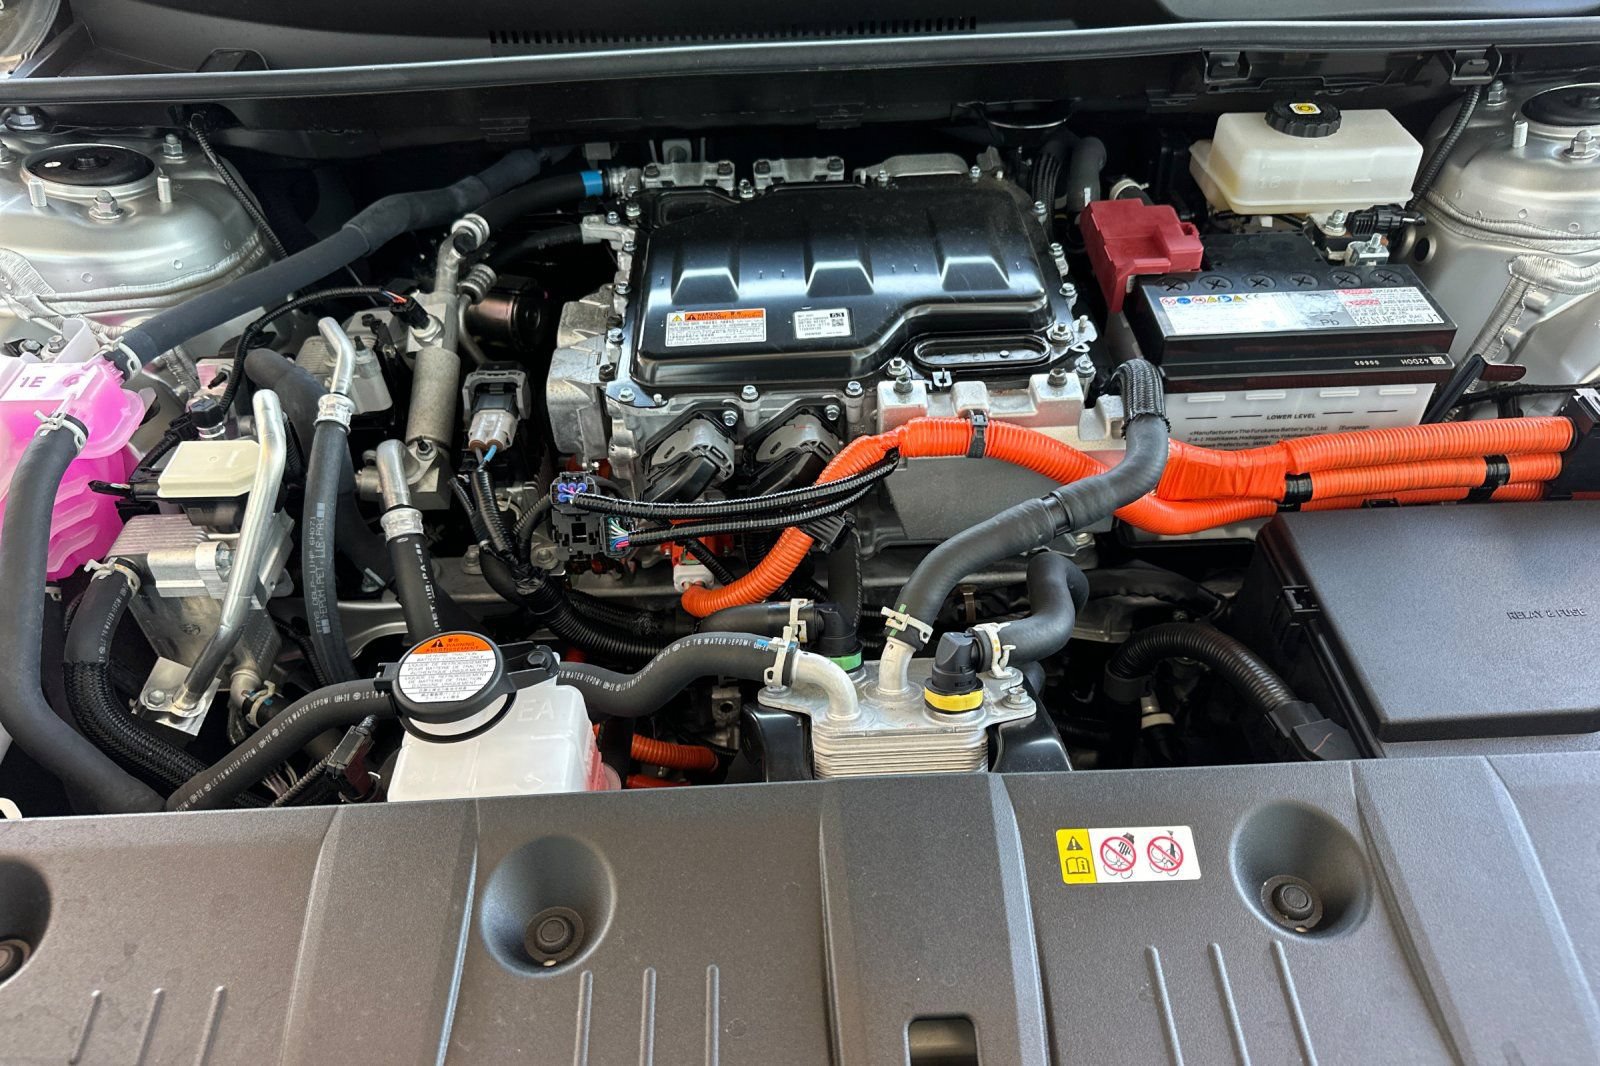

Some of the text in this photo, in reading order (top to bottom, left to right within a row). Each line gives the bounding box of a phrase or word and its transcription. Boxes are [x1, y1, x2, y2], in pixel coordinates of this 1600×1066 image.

[1506, 610, 1543, 620] RELAY
[1556, 608, 1587, 618] FUSE
[704, 637, 727, 646] WATER
[566, 671, 585, 681] WATER
[223, 759, 241, 776] WATER
[291, 704, 310, 721] WATER
